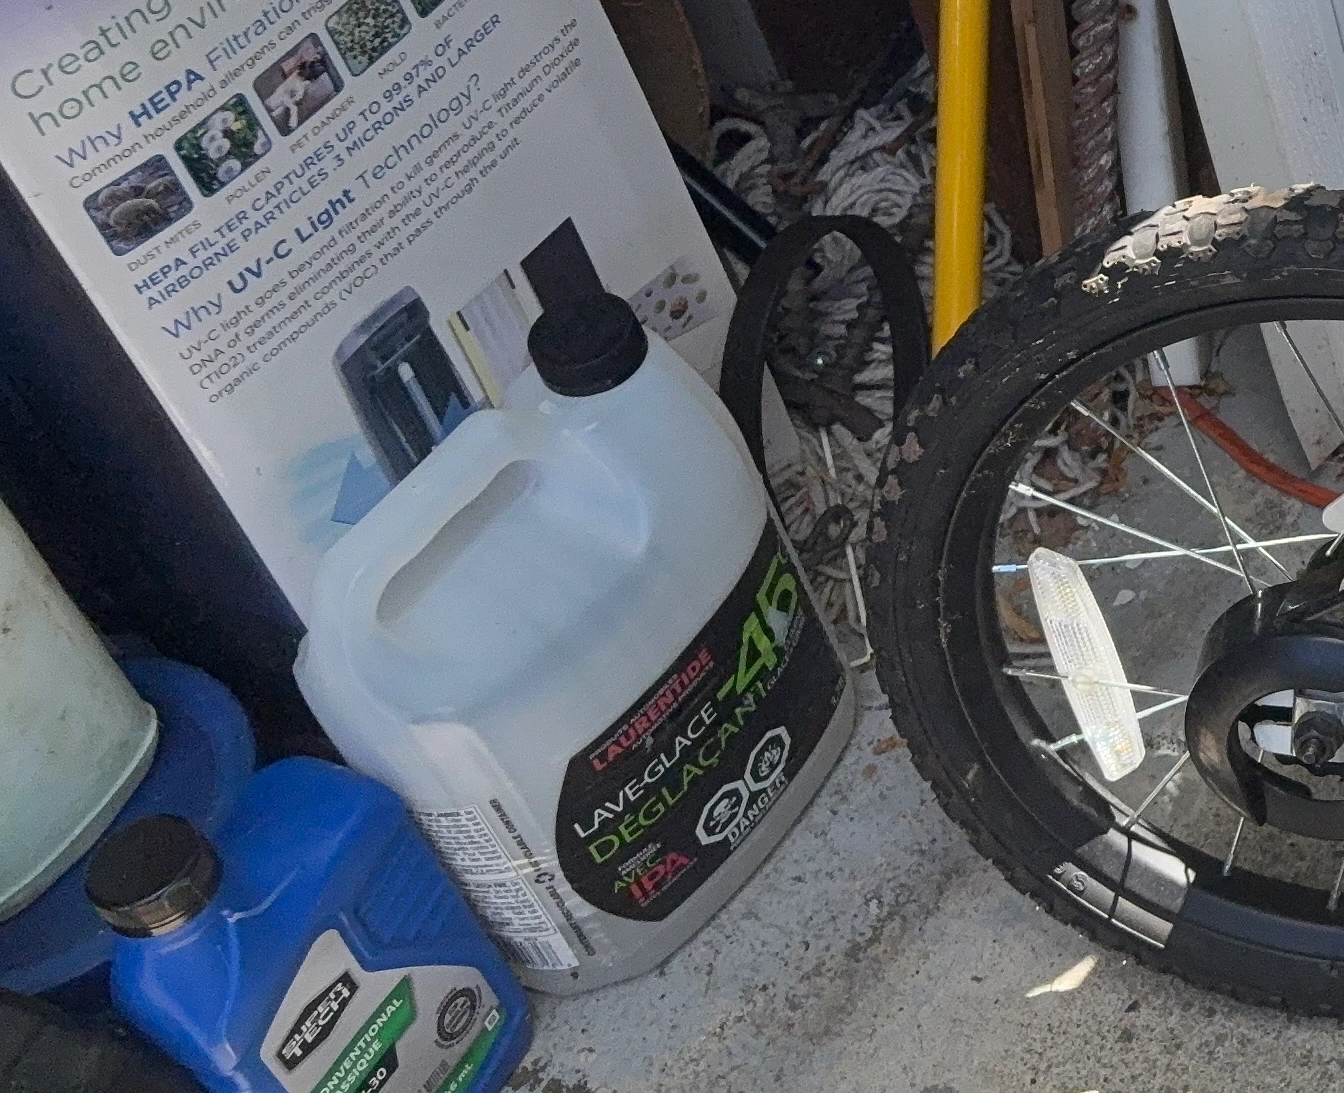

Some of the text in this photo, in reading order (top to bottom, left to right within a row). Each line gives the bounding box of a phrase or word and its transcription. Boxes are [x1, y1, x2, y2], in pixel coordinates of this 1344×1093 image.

[28, 61, 142, 136] home
[69, 142, 143, 189] Common
[143, 84, 217, 144] household
[219, 40, 276, 89] allergens
[278, 19, 301, 41] can
[378, 52, 407, 79] MOLD
[55, 123, 122, 168] Why
[128, 69, 205, 128] HEPA
[134, 34, 453, 295] HEPA FILTER CAPTURES UP TO 99.97% OF
[148, 14, 501, 309] AIRBORNE PARTICLES .3 MICRONS AND LARGER
[290, 96, 355, 154] PET DANDER
[161, 73, 480, 338] Why UV-C Light Technology?
[179, 328, 220, 360] UV-C
[220, 305, 253, 332] light
[255, 279, 287, 308] goes
[287, 236, 338, 279] beyond
[338, 194, 390, 238] filtration
[390, 181, 405, 194] to
[405, 162, 423, 181] kill
[461, 99, 492, 130] UV-C
[492, 77, 517, 103] light
[518, 36, 561, 79] destroys
[560, 18, 577, 37] the
[189, 348, 226, 375] DNA
[227, 332, 241, 348] of
[244, 300, 287, 337] germs
[288, 243, 357, 301] eliminating
[357, 217, 384, 244] their
[388, 185, 422, 219] ability
[424, 169, 438, 186] to
[496, 75, 543, 118] Titanium
[542, 38, 579, 76] Dioxide
[225, 166, 271, 204] POLLEN
[246, 300, 312, 354] treatment
[313, 249, 373, 301] combines
[373, 226, 401, 249] with
[401, 207, 422, 226] the
[419, 176, 454, 207] UV-C
[454, 141, 496, 180] helping
[495, 128, 508, 141] to
[509, 93, 544, 129] reduce
[545, 58, 581, 93] volatile
[127, 220, 202, 272] DUST MITES
[209, 362, 261, 403] organic
[262, 300, 337, 363] compounds
[339, 264, 378, 301] (VOC)
[379, 242, 404, 266] that
[406, 218, 433, 245] pass
[433, 177, 479, 219] through
[479, 157, 498, 178] the
[592, 648, 712, 771] LAURENTIDE
[573, 702, 718, 838] LAVE-GLACE
[727, 772, 788, 843] DANGER
[615, 853, 660, 893] AVEC
[631, 852, 690, 899] IPA
[282, 982, 345, 1059] SUPER
[287, 987, 350, 1058] TECH
[320, 998, 403, 1093] ONVENTIONAL
